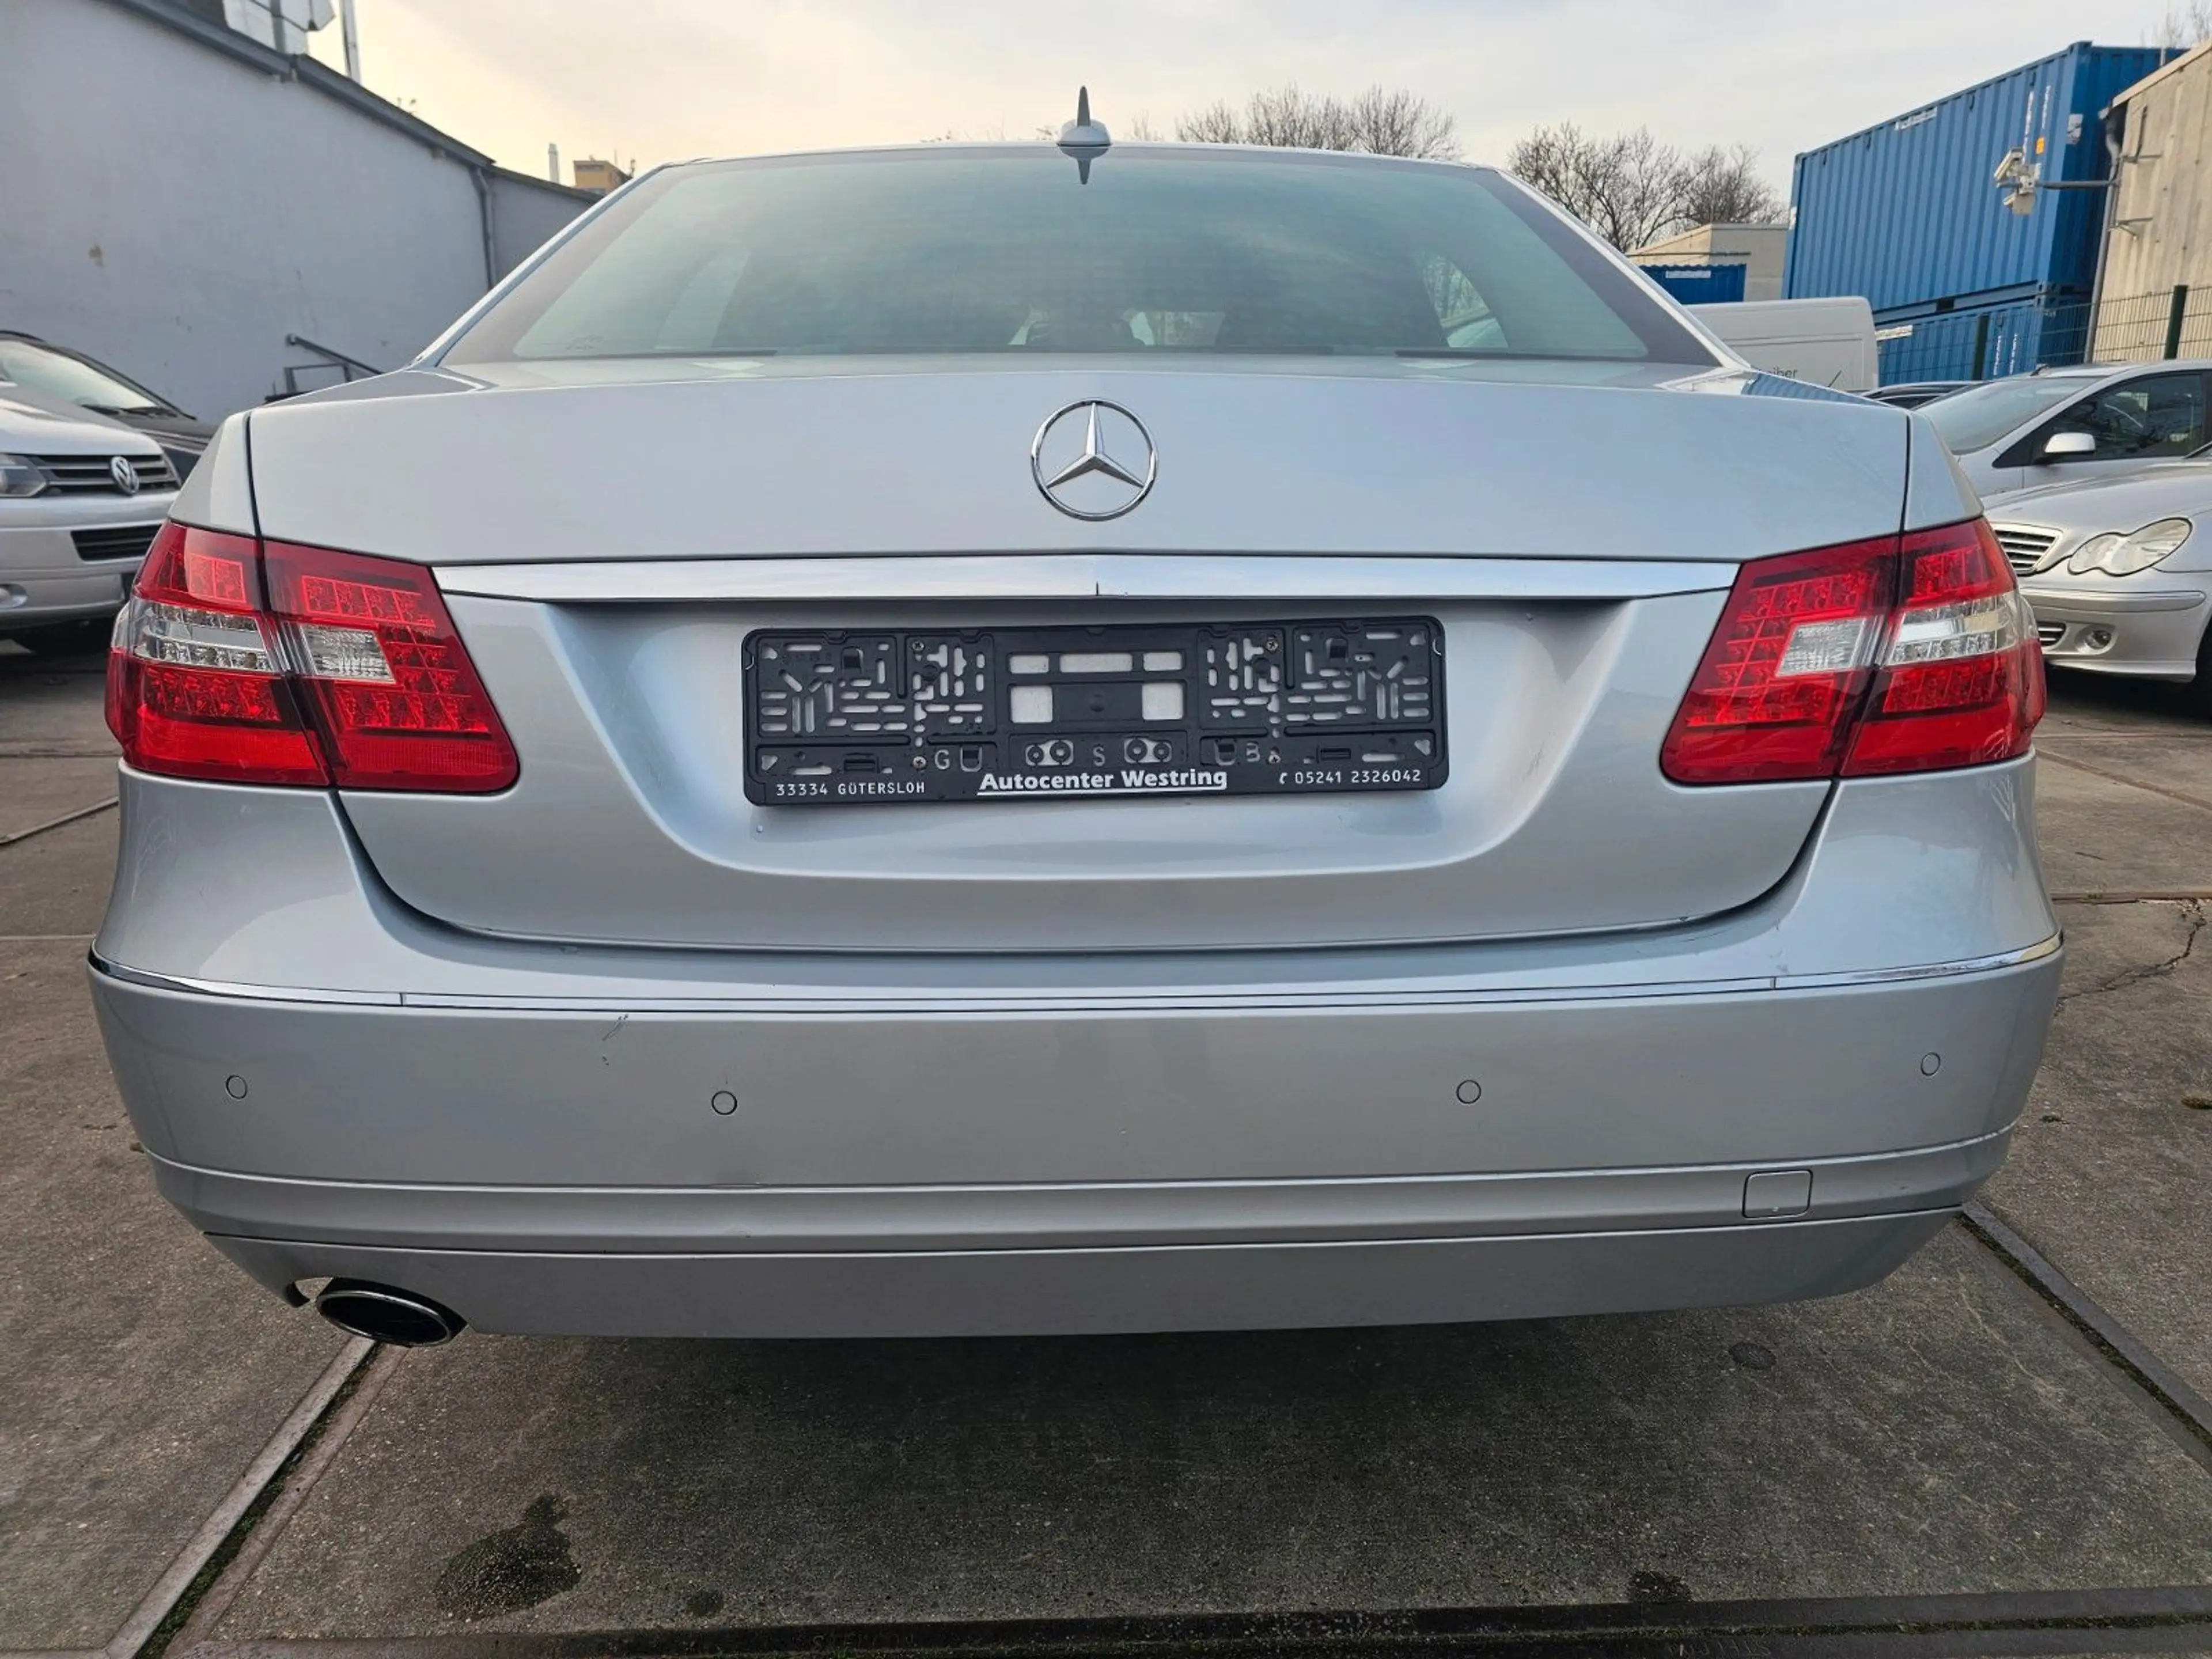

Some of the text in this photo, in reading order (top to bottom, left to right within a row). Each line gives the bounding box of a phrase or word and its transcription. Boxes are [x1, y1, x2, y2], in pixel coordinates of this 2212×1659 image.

[979, 768, 1227, 790] Autocenter Westring
[1295, 769, 1421, 784] 05241 2326042
[776, 781, 925, 796] 33334 GÜTERSLOH
